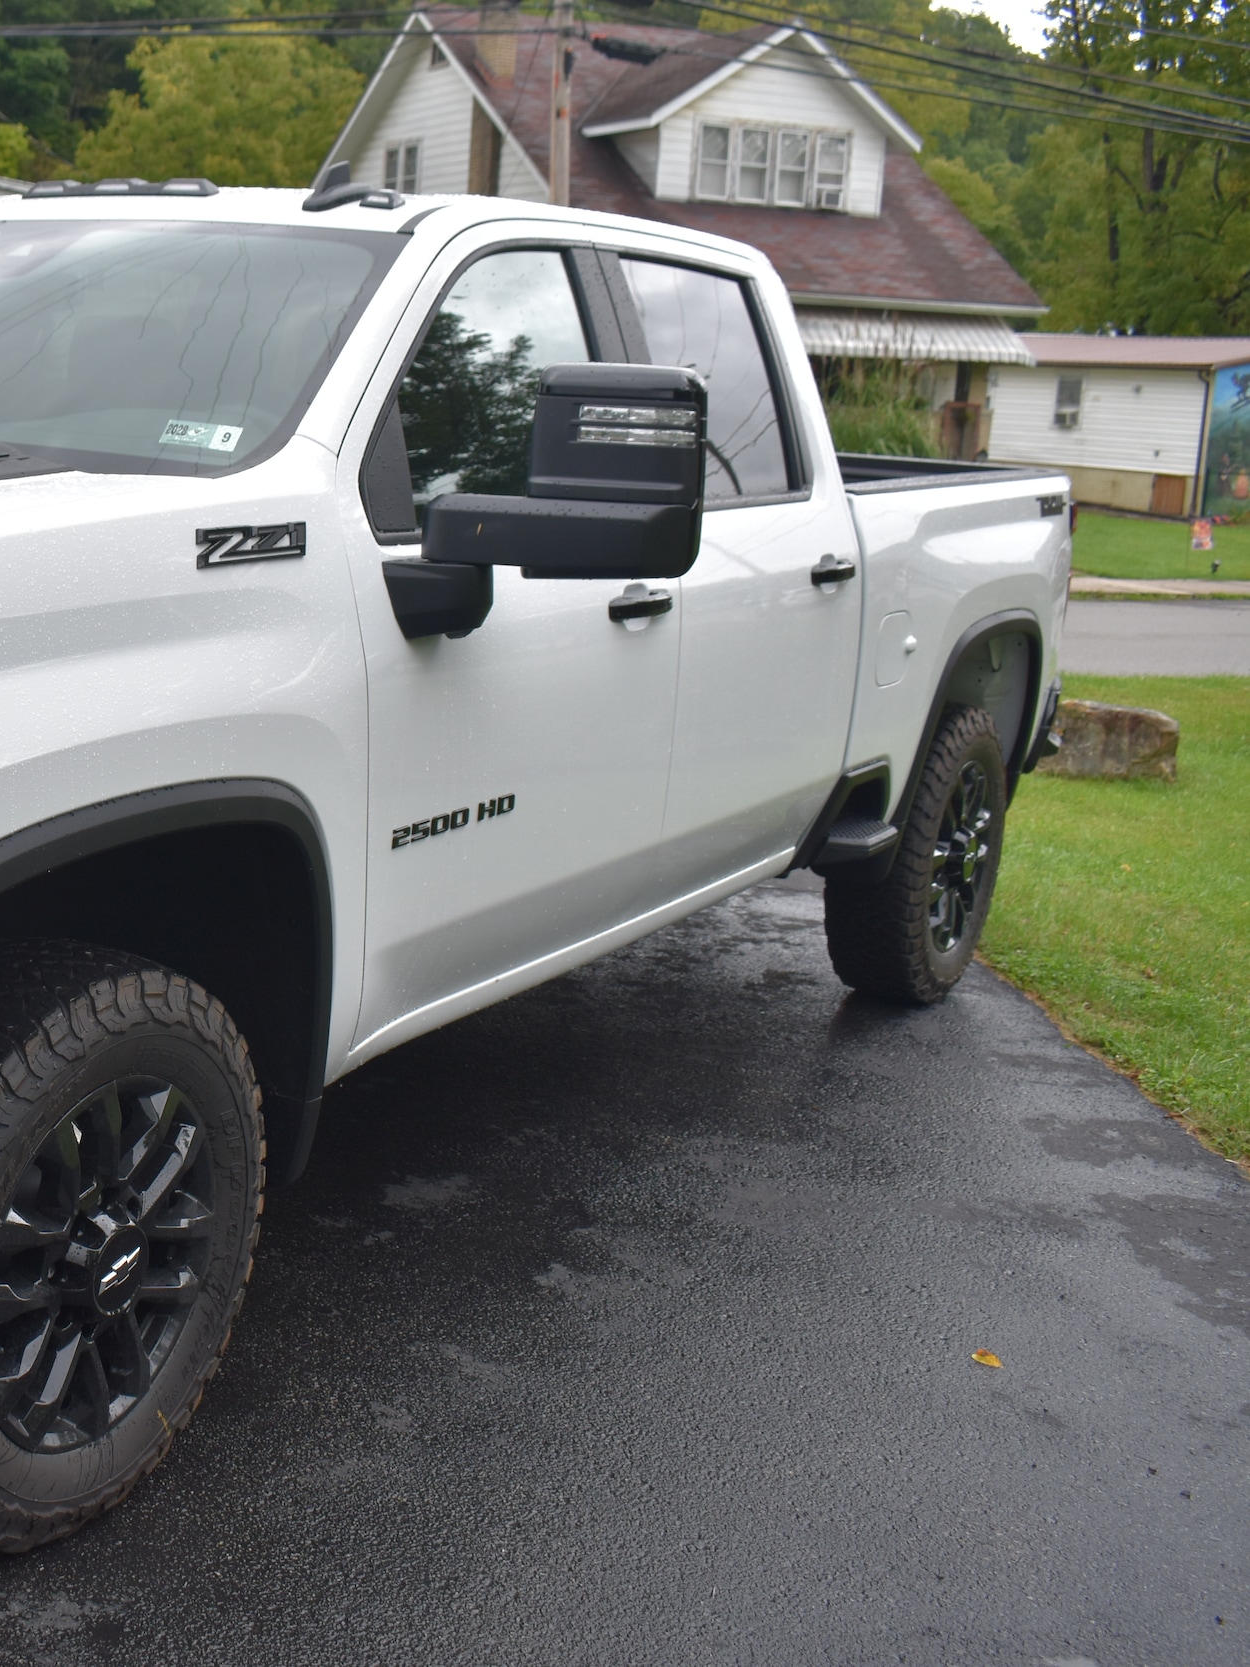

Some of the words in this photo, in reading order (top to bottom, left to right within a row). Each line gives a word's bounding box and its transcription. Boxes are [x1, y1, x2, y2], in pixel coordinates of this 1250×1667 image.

[221, 431, 232, 444] 9
[391, 806, 470, 850] 2500
[477, 792, 516, 822] HD
